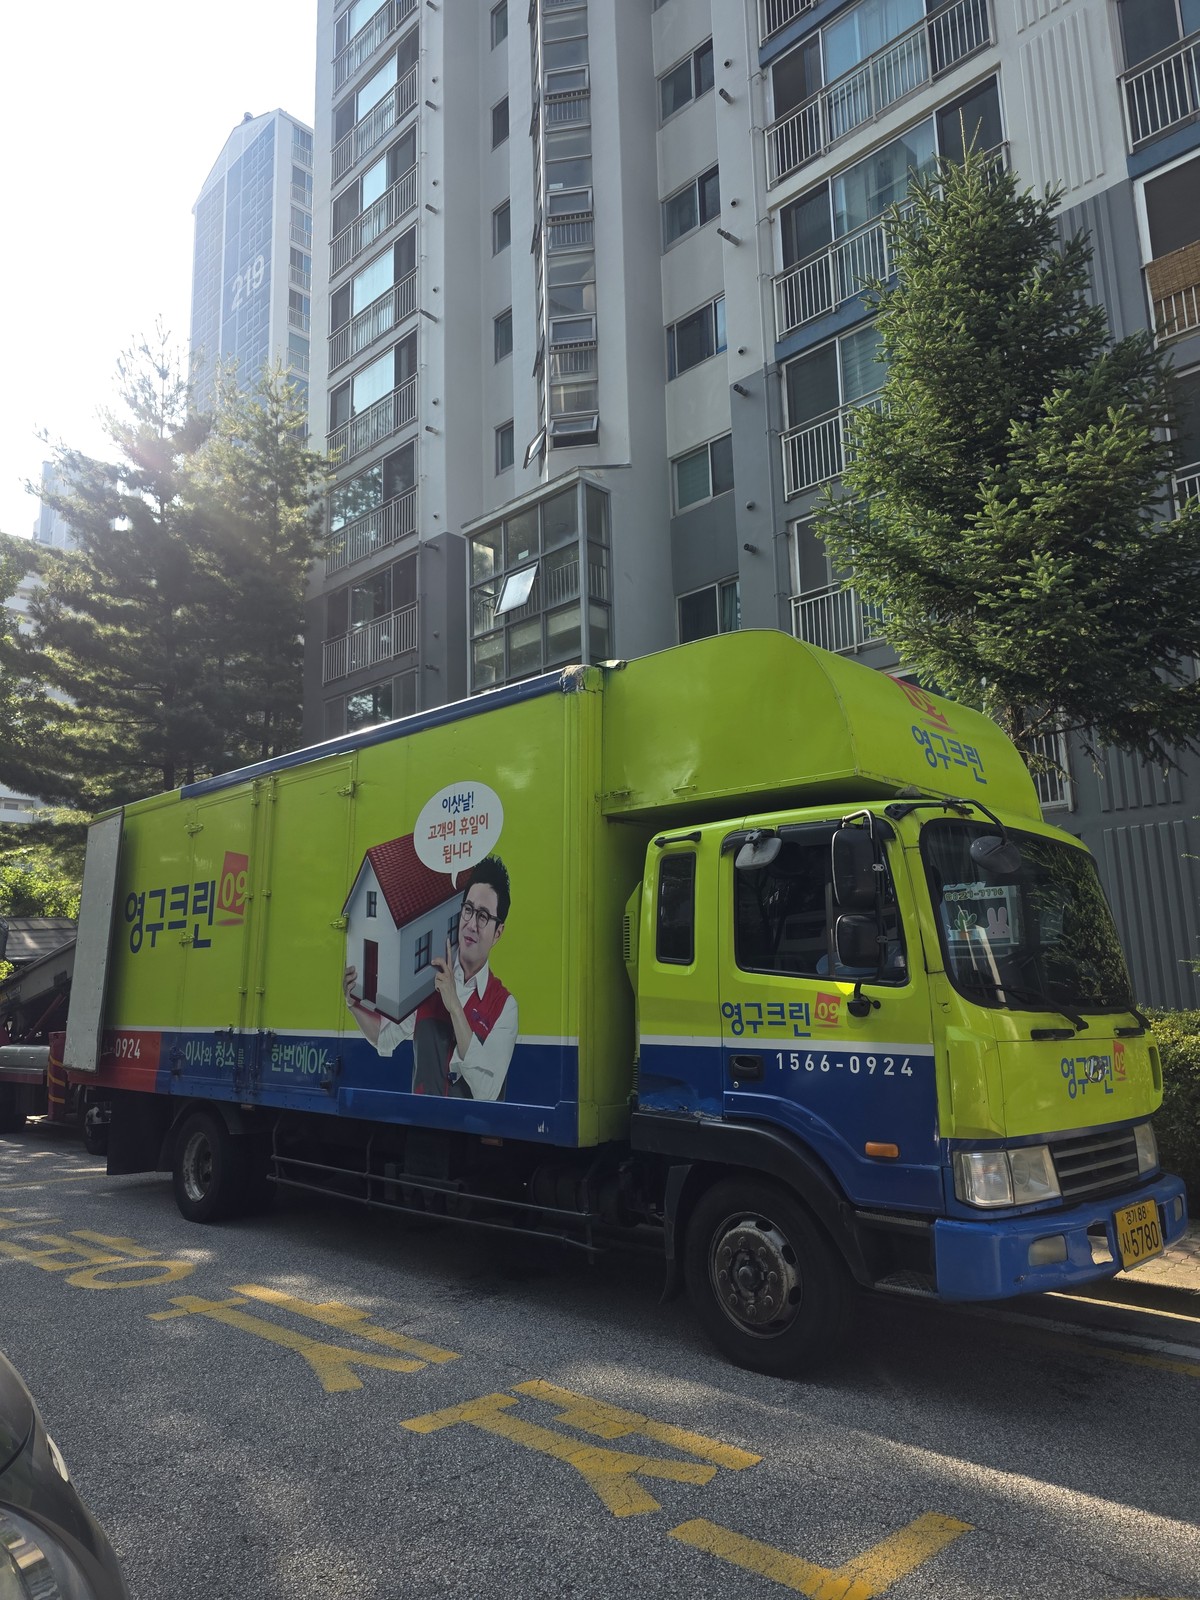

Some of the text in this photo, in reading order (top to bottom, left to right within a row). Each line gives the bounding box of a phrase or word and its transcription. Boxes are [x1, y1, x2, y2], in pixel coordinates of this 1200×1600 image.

[231, 254, 265, 312] 219
[911, 725, 987, 784] 영구크린
[441, 791, 475, 814] 이삿날!
[427, 812, 489, 841] 고객의 휴일이
[442, 840, 472, 864] 됩니다
[124, 870, 248, 954] 영구크린 09
[721, 1001, 840, 1038] 영구크린 09
[185, 1040, 213, 1067] 이사와
[775, 1052, 913, 1077] 1566-0924
